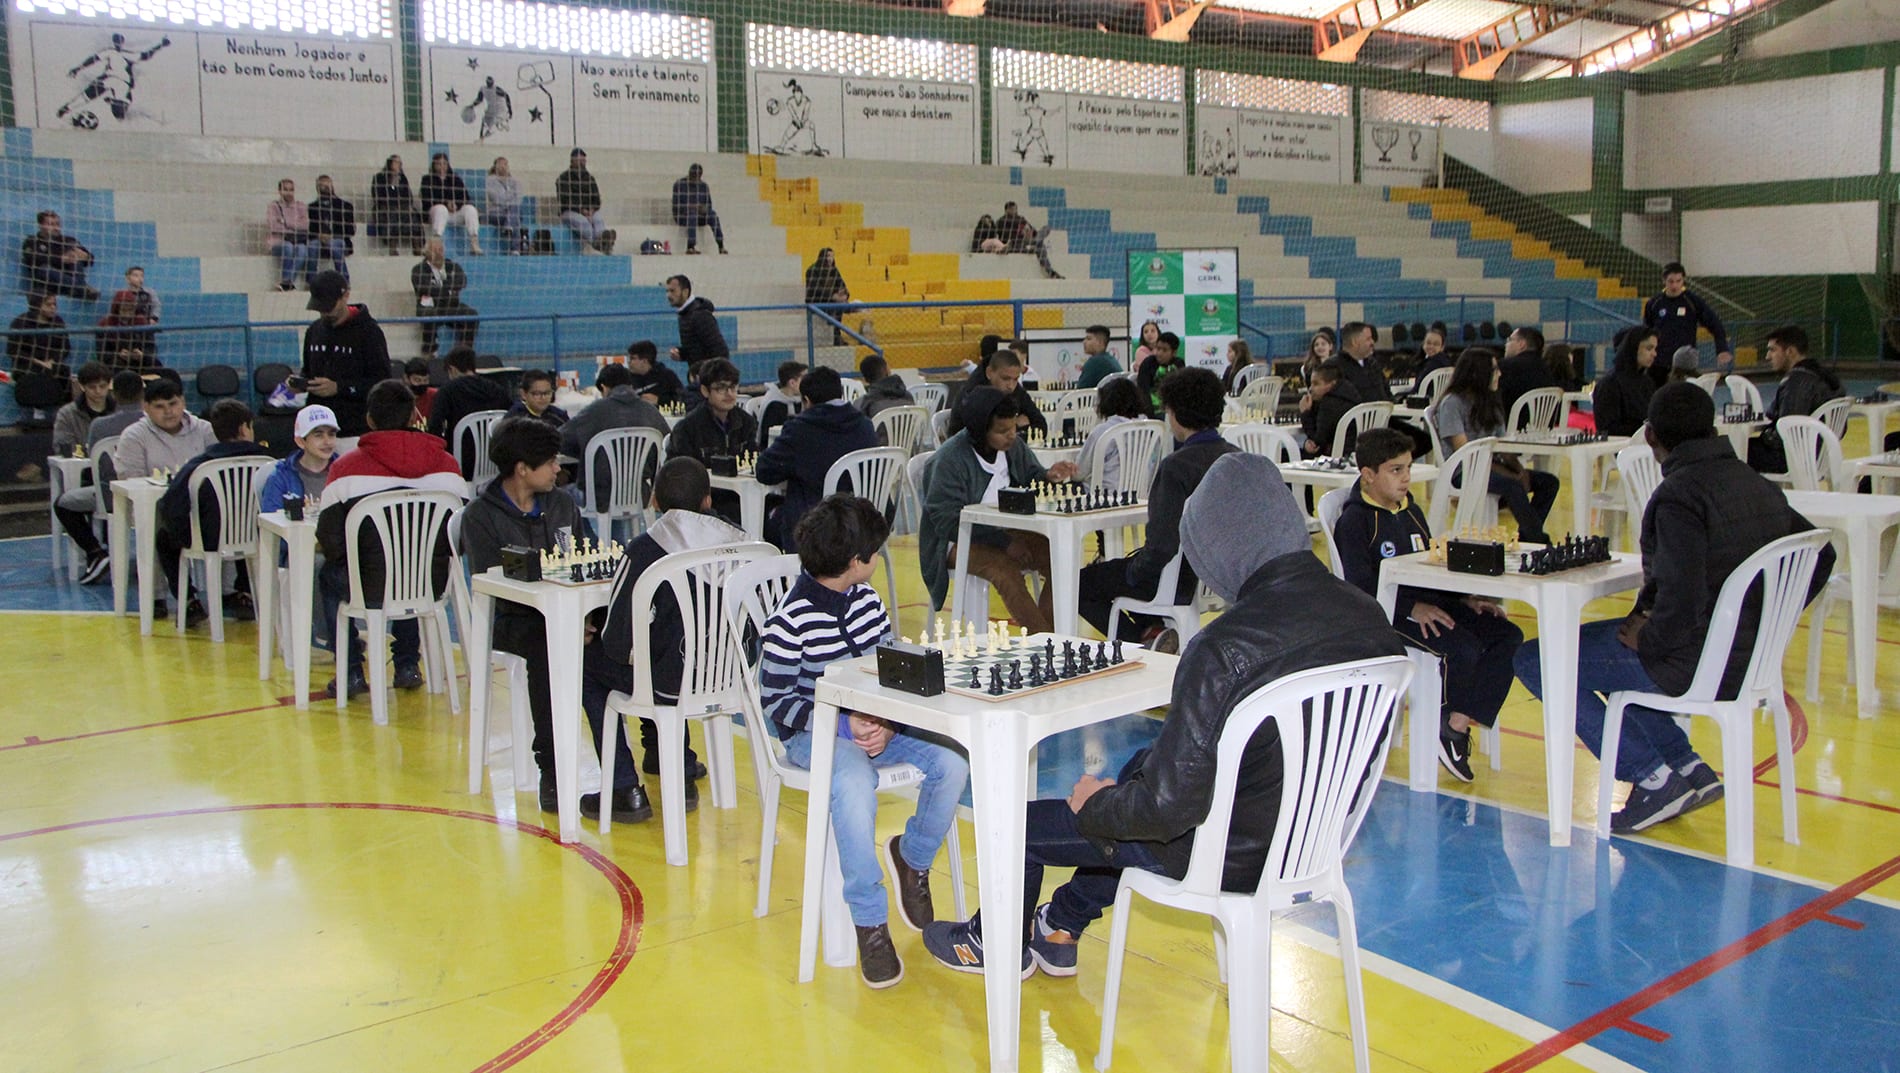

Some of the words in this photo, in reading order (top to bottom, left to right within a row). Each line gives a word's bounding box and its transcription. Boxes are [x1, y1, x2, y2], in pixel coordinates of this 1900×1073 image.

[226, 37, 286, 58] Nenhum
[295, 42, 352, 62] Jogador
[234, 62, 266, 77] bom
[268, 63, 306, 79] Como
[310, 65, 347, 82] todos
[350, 67, 389, 84] Juntos
[609, 62, 649, 80] existe
[653, 65, 700, 83] talento
[593, 82, 621, 99] Sem
[625, 84, 701, 104] Treinamento
[863, 106, 880, 120] que
[952, 943, 980, 966] N
